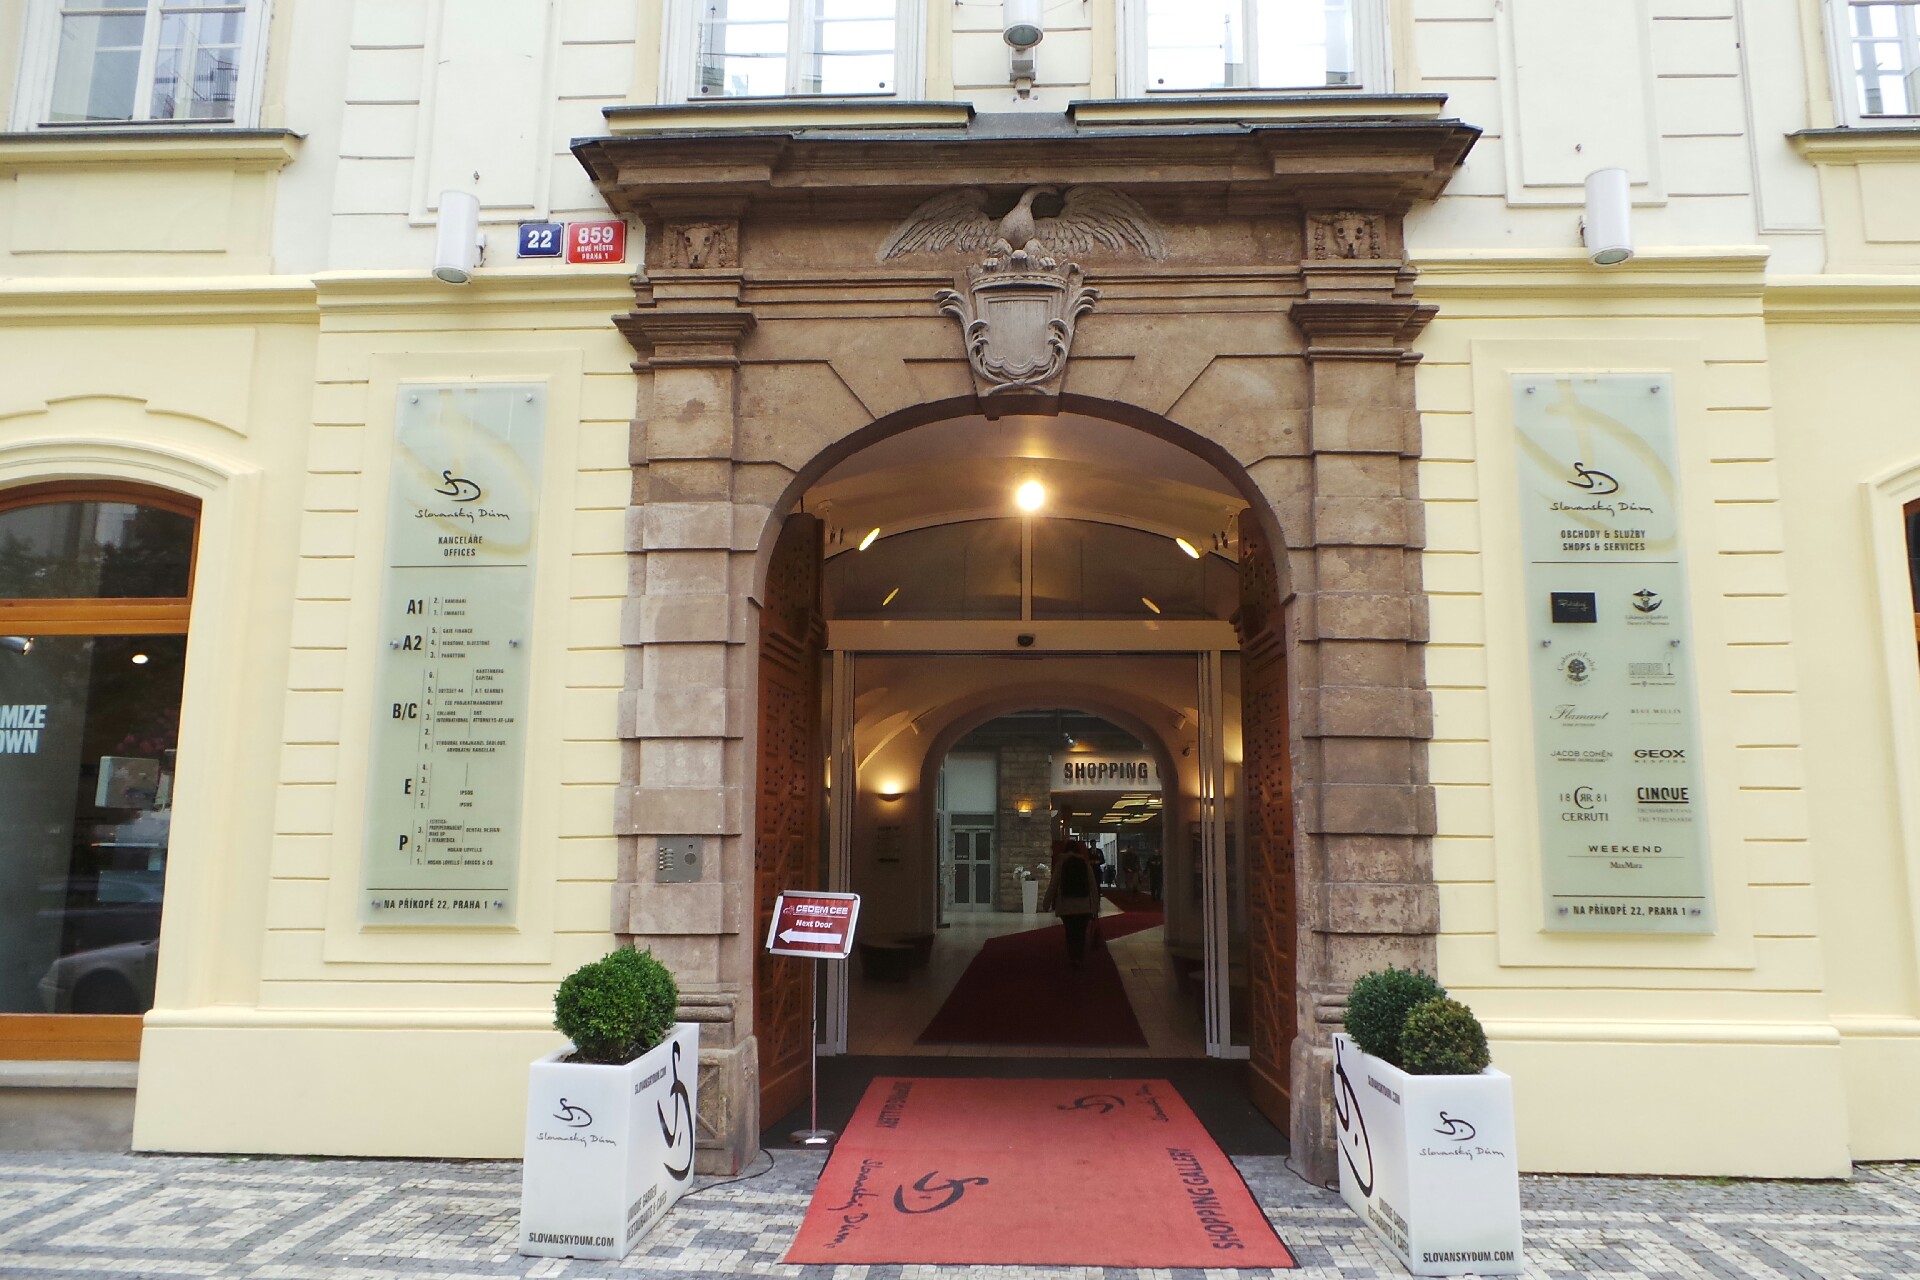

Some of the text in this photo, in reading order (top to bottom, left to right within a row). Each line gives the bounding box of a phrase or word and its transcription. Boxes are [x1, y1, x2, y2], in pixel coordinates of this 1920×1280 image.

[528, 230, 552, 248] 22
[578, 226, 614, 244] 859
[577, 244, 591, 252] NOVÉ
[1560, 528, 1646, 538] OBCHODY & SLUŽBY
[444, 548, 476, 556] OFFICES
[406, 599, 423, 614] A1
[402, 635, 422, 650] A2
[0, 704, 47, 728] MIZE
[392, 702, 418, 720] B/C
[1550, 704, 1609, 720] Flamant
[1634, 750, 1685, 758] GEOX
[1064, 762, 1148, 778] SHOPPING
[404, 778, 412, 794] E
[1638, 788, 1689, 800] CINQUE
[1562, 813, 1608, 822] CERRUTI
[399, 835, 408, 850] P
[384, 900, 396, 908] NA
[453, 900, 480, 908] PRAHA
[1574, 906, 1586, 914] NA
[1649, 906, 1678, 915] PRAHA
[1682, 907, 1686, 915] 1
[1166, 1148, 1244, 1249] SHOPPING GALLERY
[528, 1232, 614, 1247] SLOVANSKYDUM.COM
[1423, 1251, 1514, 1263] SLOVANSKYDUM.COM
